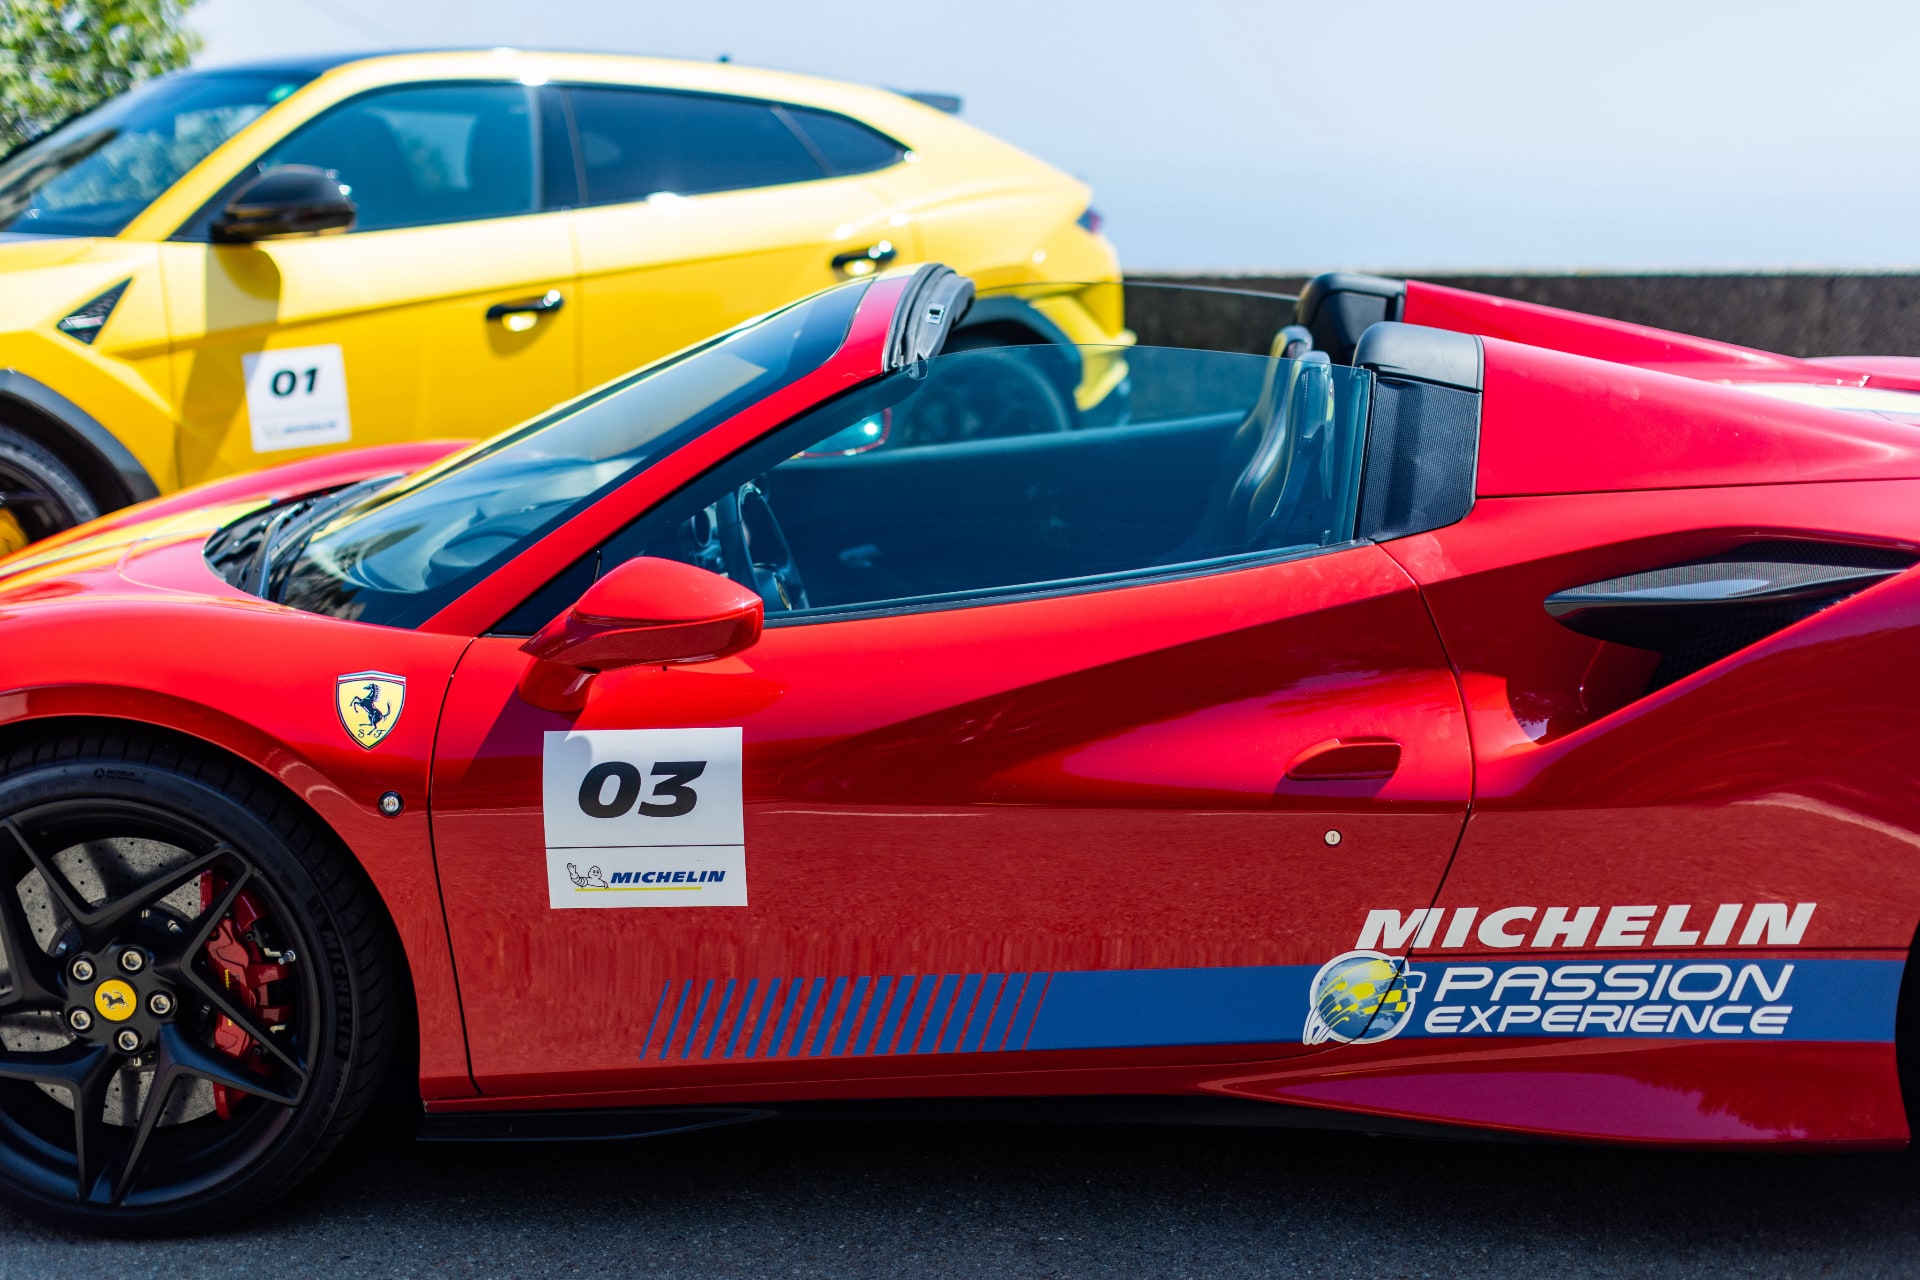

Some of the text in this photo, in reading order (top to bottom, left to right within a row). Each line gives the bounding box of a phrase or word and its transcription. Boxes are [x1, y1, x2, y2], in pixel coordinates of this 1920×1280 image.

[270, 366, 318, 396] 01
[578, 761, 707, 818] 03
[610, 870, 726, 884] MICHELIN
[1354, 902, 1817, 950] MICHELIN
[324, 932, 349, 1053] MICHELIN
[1434, 964, 1795, 1002] PASSION
[1424, 1004, 1793, 1034] EXPERIENCE
